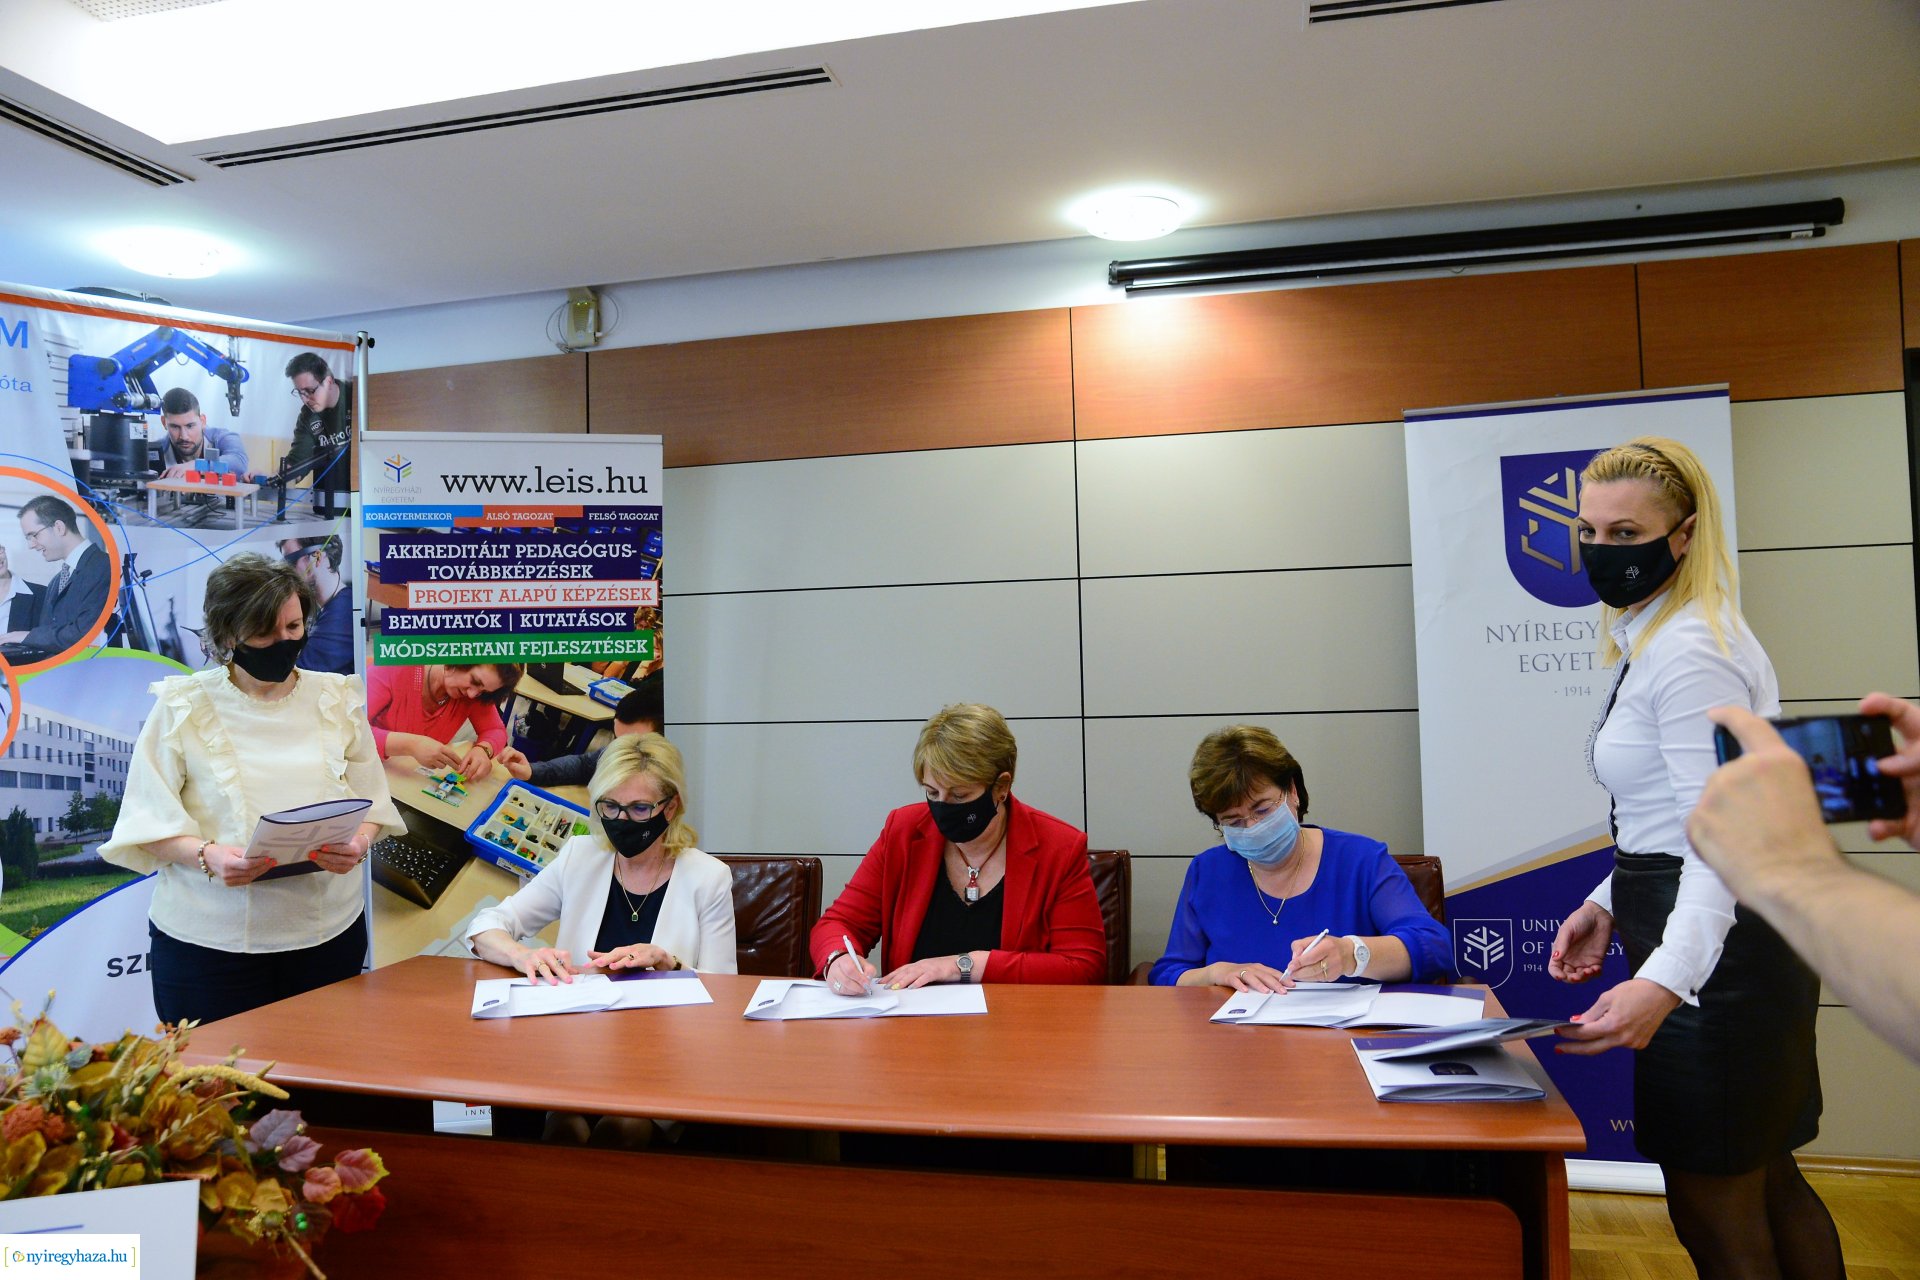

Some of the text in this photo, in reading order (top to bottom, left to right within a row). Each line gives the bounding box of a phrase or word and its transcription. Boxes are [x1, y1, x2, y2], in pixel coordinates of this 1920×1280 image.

[440, 465, 648, 494] www.leis.hu
[373, 485, 422, 494] NYÍREGYHÁZI
[365, 512, 453, 521] KORAGYERMEKKOR
[486, 511, 554, 521] ALSÓ TAGOZAT
[588, 510, 660, 521] FELSŐ TAGOZAT
[386, 540, 637, 559] AKKREDITÁLT PEDAGÓGUS-
[428, 561, 594, 580] TOVÁBBKÉPZÉSEK
[415, 583, 653, 604] PROJEKT ALAPÚ KÉPZÉSEK
[388, 610, 502, 630] BEMUTATÓK
[520, 609, 627, 628] KUTATÁSOK
[380, 636, 648, 659] MÓDSZERTANI FEJLESZTÉSEK
[1519, 651, 1613, 673] EGYET
[1564, 686, 1592, 697] 1914
[1522, 941, 1544, 954] OF
[1523, 964, 1543, 972] 1914
